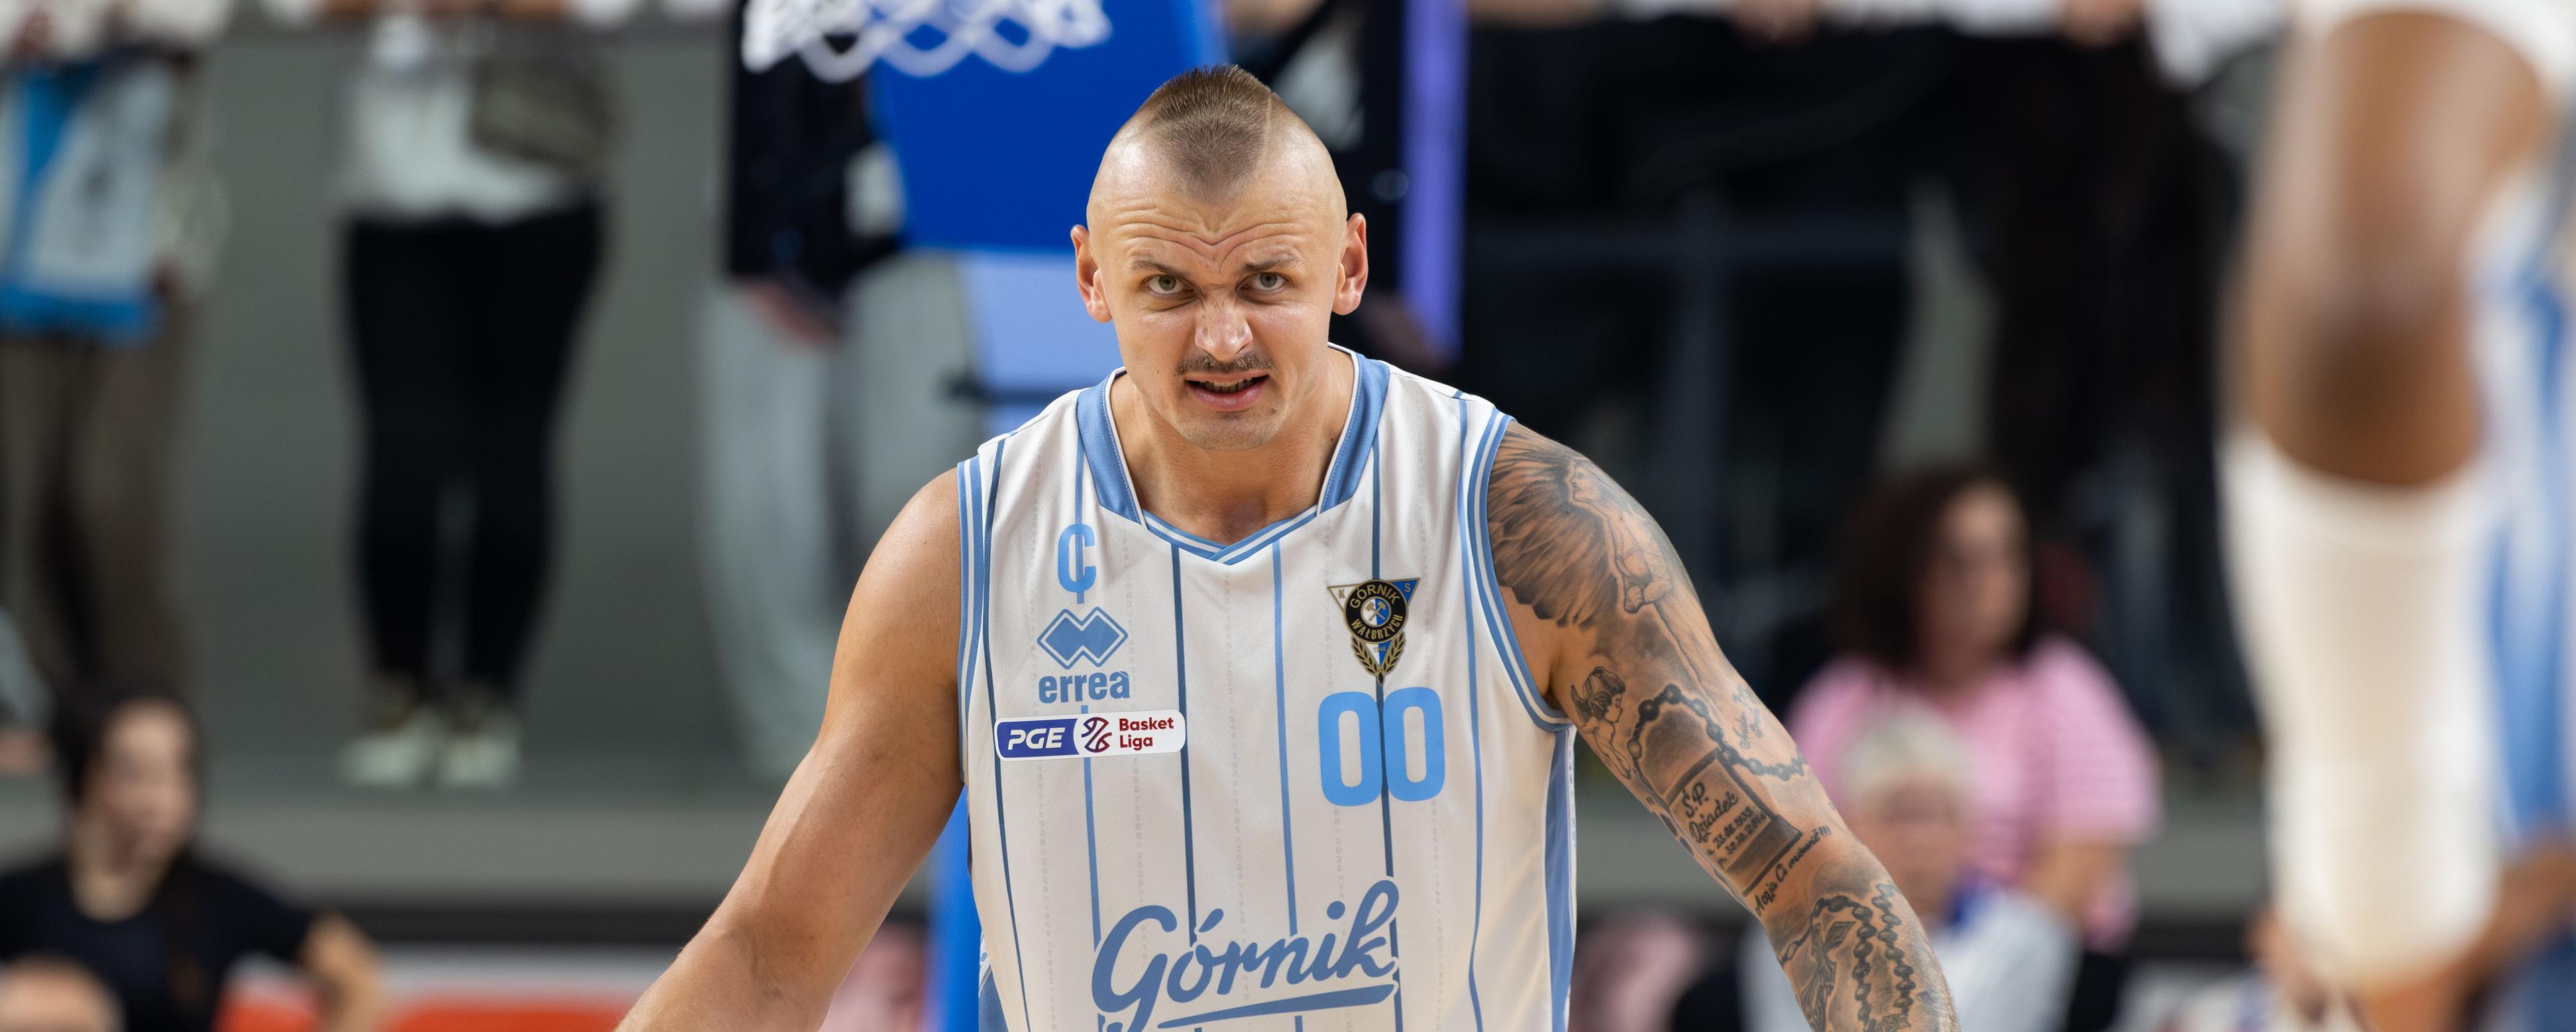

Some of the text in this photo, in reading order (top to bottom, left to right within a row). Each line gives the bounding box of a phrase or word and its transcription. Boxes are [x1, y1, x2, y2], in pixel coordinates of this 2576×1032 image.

[1057, 523, 1096, 593] C
[1338, 583, 1411, 599] K S
[1350, 584, 1401, 608] GÓRNIK
[1351, 614, 1403, 640] WAŁBRZYCH
[1119, 717, 1174, 732] Basket
[1008, 727, 1065, 750] PGE
[1120, 734, 1153, 751] Liga
[1318, 687, 1446, 807] 00
[1688, 791, 1739, 843] Dziadek
[1091, 880, 1400, 1032] Górnik
